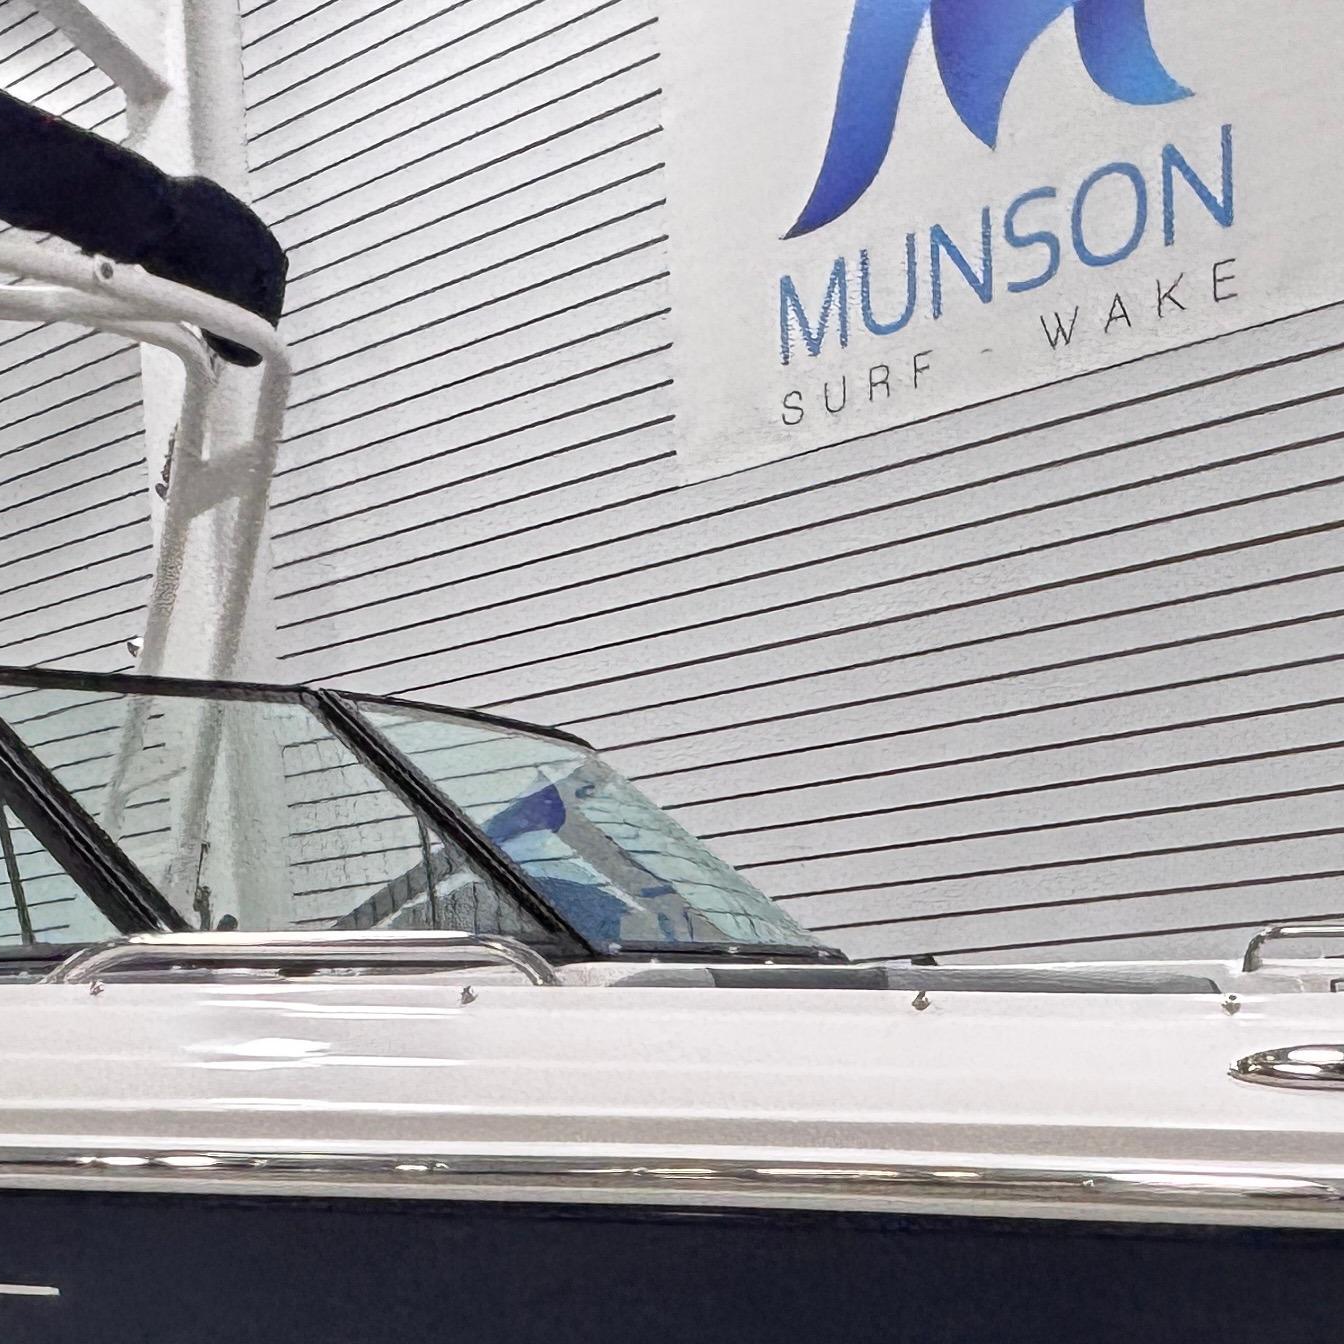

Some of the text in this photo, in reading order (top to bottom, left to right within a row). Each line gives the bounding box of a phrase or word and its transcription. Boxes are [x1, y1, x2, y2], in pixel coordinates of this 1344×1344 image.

[779, 123, 1234, 366] MUNSON
[781, 350, 934, 426] SURF
[1039, 258, 1238, 351] WAKE
